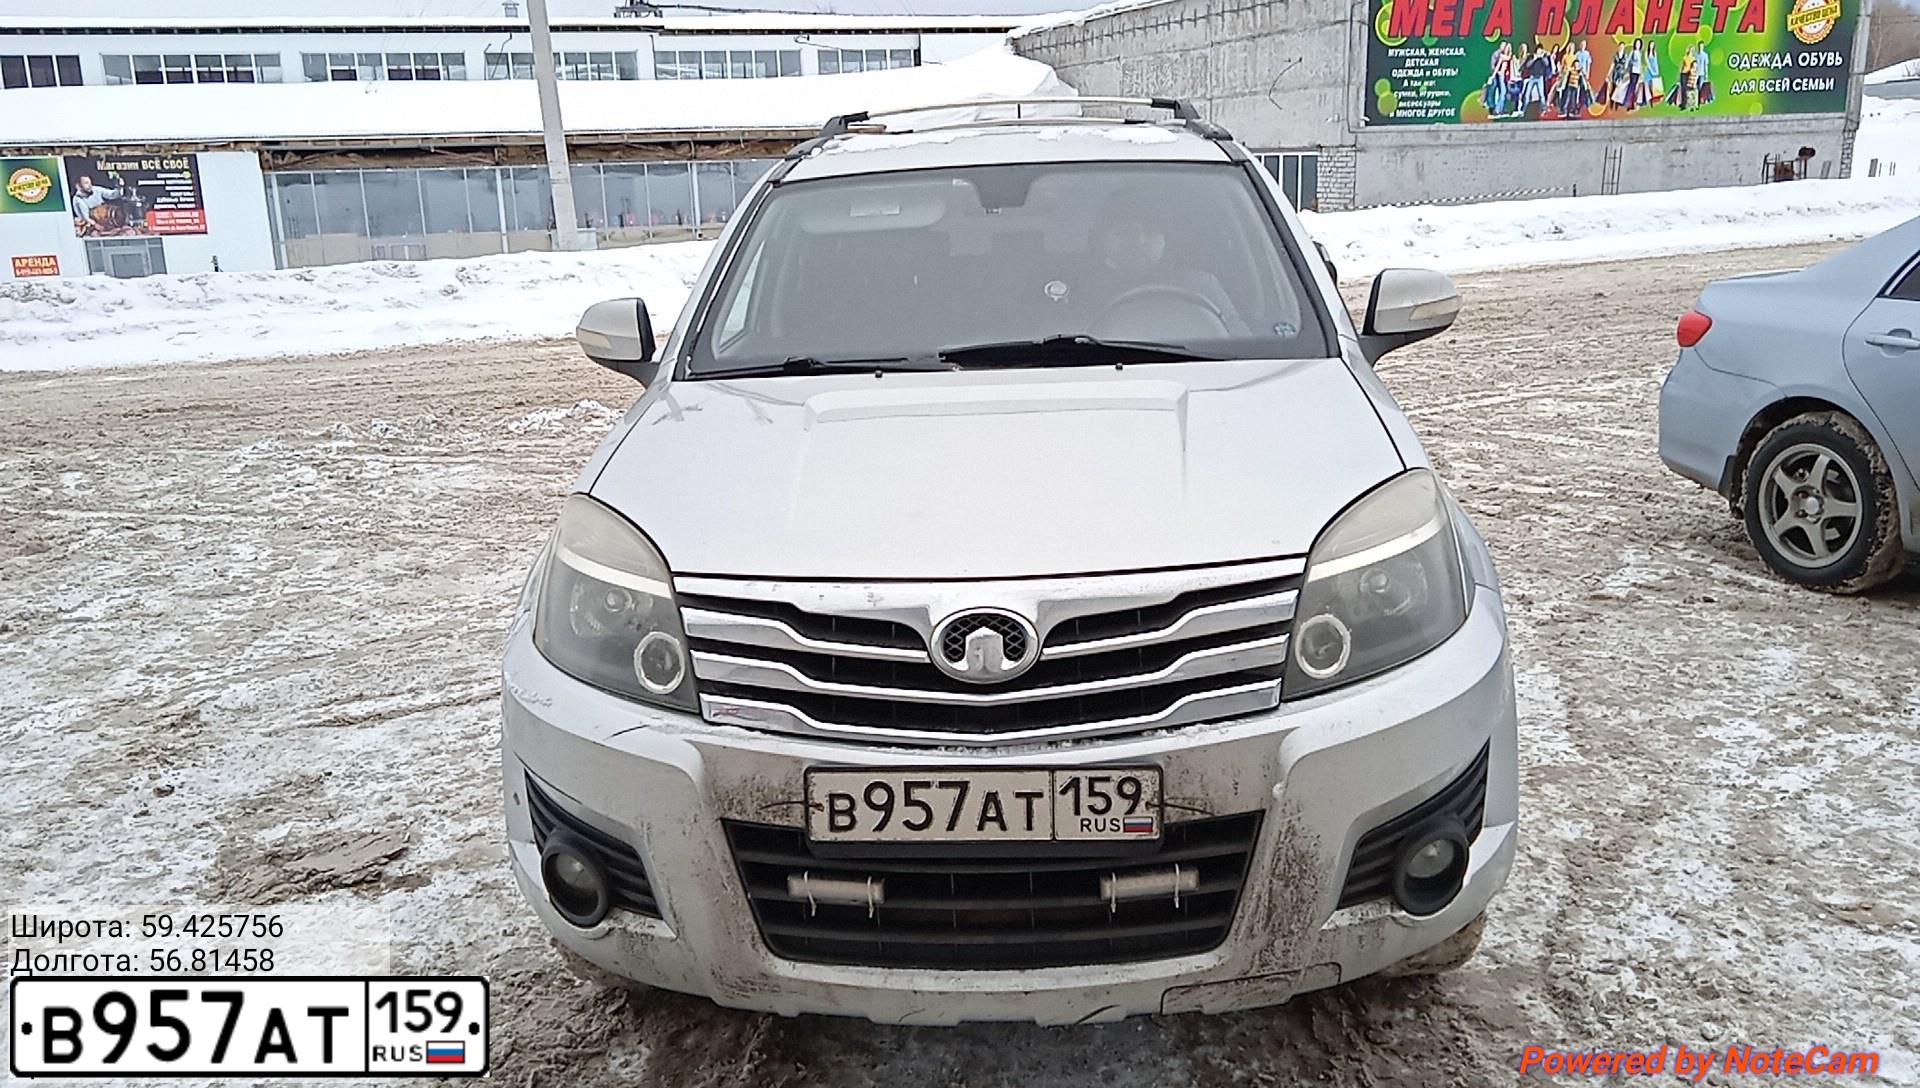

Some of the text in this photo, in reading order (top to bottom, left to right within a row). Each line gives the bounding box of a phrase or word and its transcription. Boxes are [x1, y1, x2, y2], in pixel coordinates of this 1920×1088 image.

[1388, 0, 1766, 37] МЕГА ПЛАНЕТА
[1405, 58, 1440, 68] ДЕТСКАЯ
[1728, 51, 1843, 70] ОДЕЖДА ОБУВЬ
[1391, 69, 1424, 78] ОДЕЖДА
[1730, 77, 1835, 95] ДЛЯ ВСЕЙ СЕМЬИ
[1396, 109, 1426, 118] МНОГОЕ
[15, 257, 56, 268] АРЕНДА
[1058, 776, 1143, 816] 159
[1080, 817, 1121, 833] RUS
